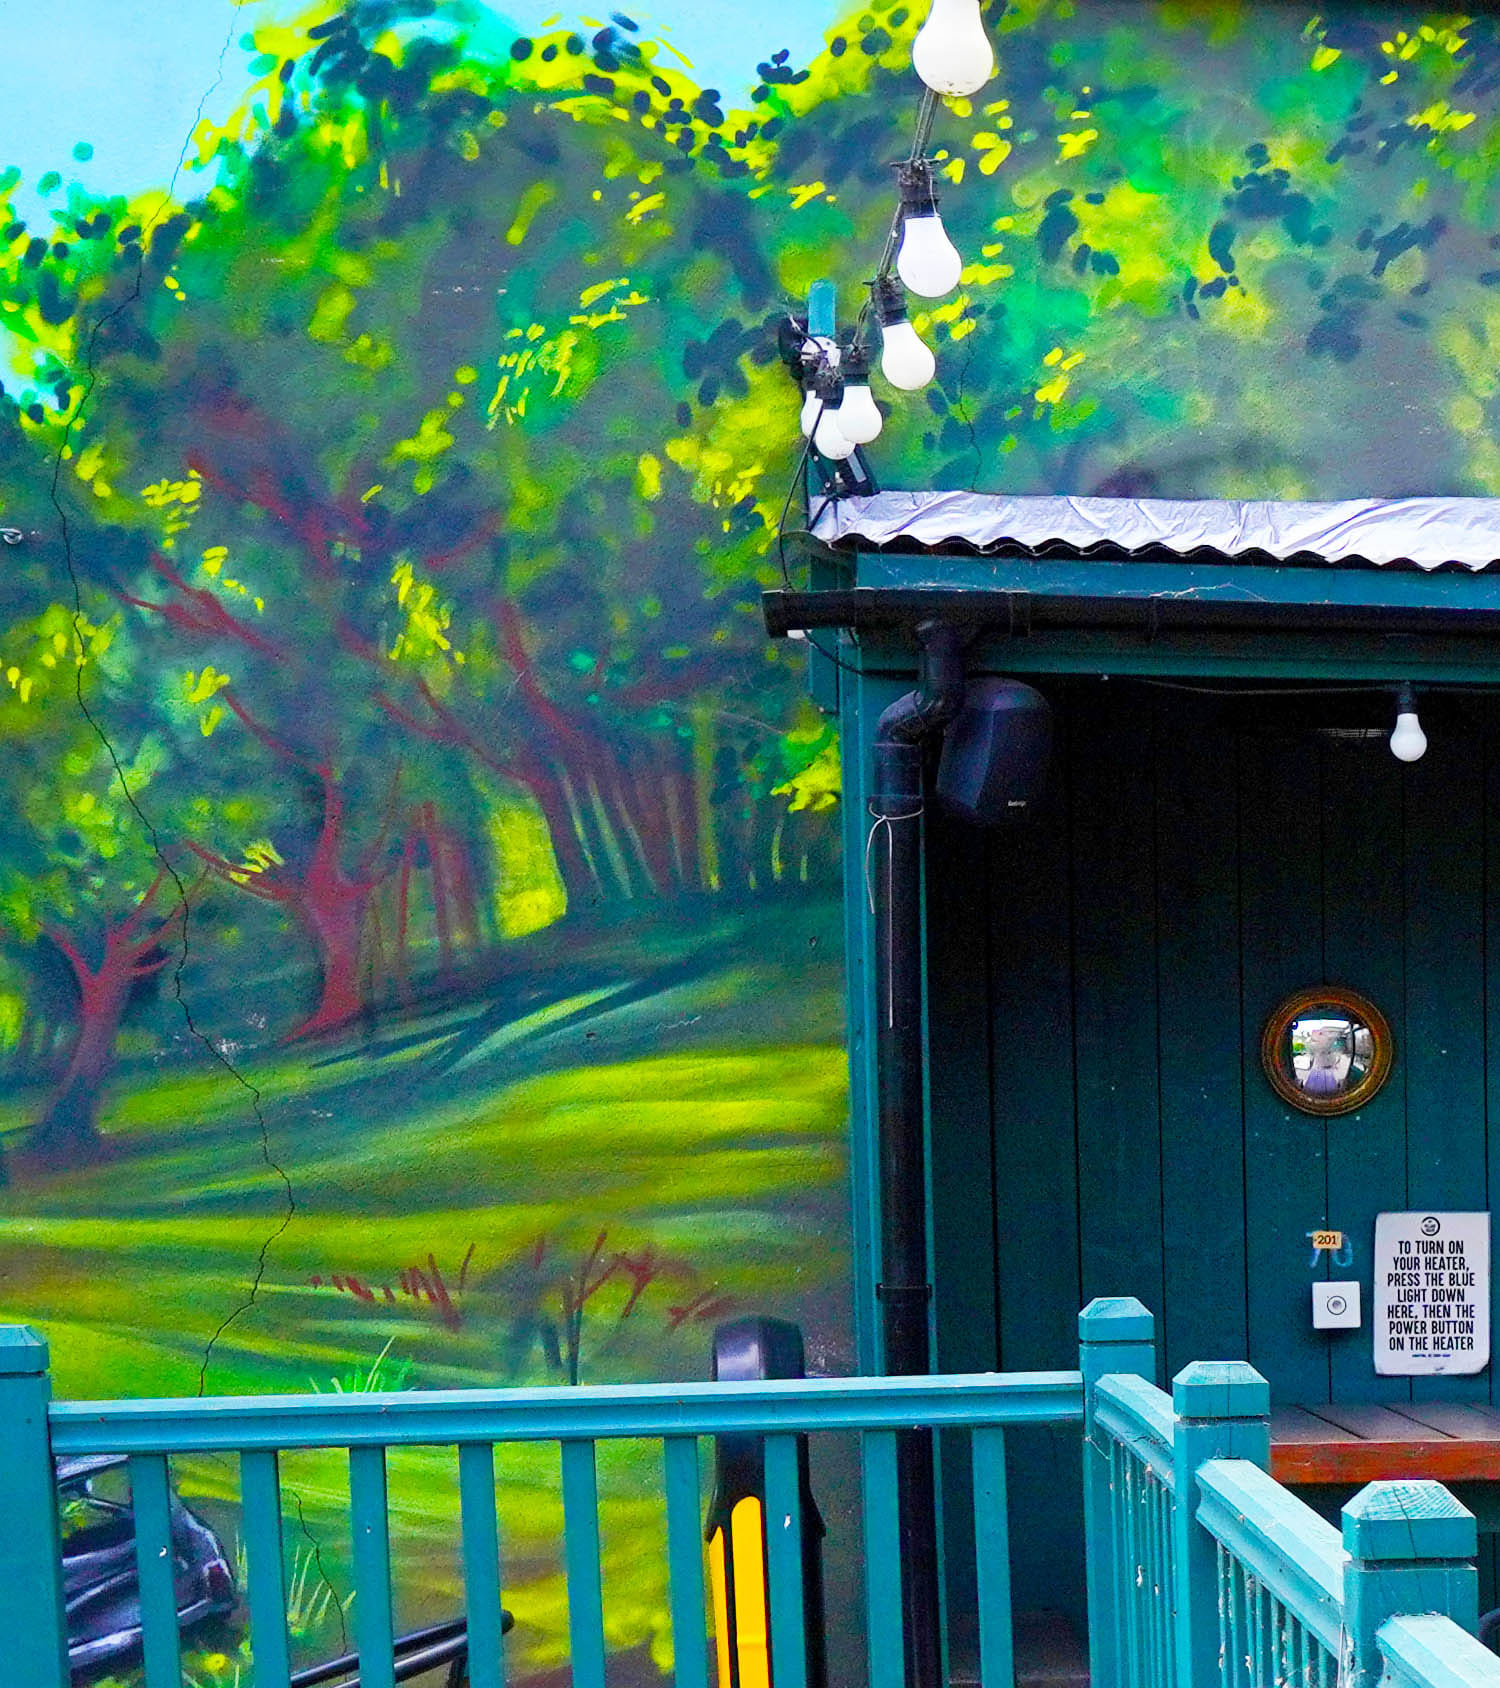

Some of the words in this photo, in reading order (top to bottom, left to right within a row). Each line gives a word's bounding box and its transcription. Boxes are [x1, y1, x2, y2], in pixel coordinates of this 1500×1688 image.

[1317, 1234, 1338, 1245] 201
[1398, 1240, 1411, 1255] TO
[1415, 1240, 1444, 1255] TURN
[1448, 1240, 1464, 1255] ON
[1393, 1256, 1421, 1271] YOUR
[1425, 1256, 1470, 1272] HEATER,
[1387, 1272, 1421, 1287] PRESS
[1424, 1272, 1444, 1287] THE
[1449, 1272, 1475, 1287] BLUE
[1397, 1288, 1427, 1303] LIGHT
[1432, 1288, 1465, 1303] DOWN
[1387, 1304, 1418, 1320] HERE,
[1422, 1304, 1451, 1319] THEN
[1455, 1304, 1475, 1319] THE
[1389, 1320, 1427, 1335] POWER
[1431, 1320, 1474, 1335] BUTTON
[1389, 1337, 1405, 1351] ON
[1408, 1336, 1429, 1351] THE
[1433, 1336, 1474, 1351] HEATER
